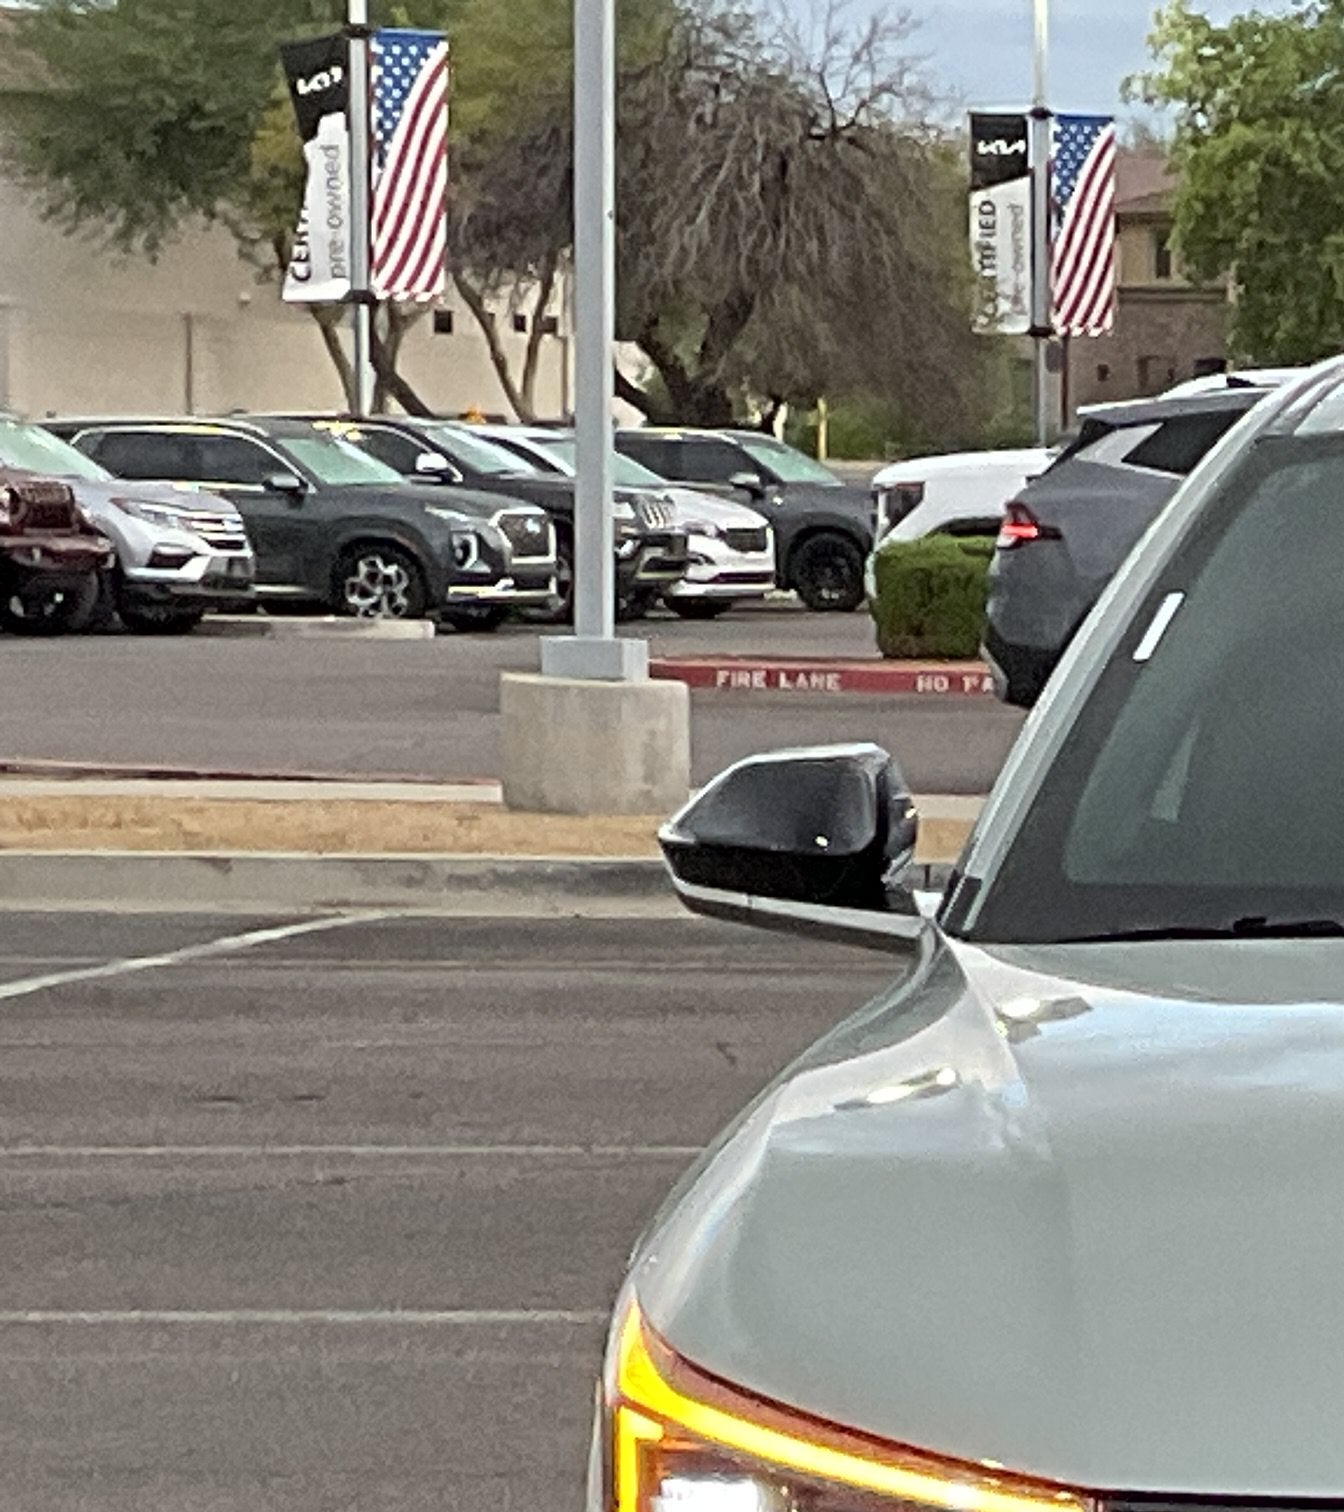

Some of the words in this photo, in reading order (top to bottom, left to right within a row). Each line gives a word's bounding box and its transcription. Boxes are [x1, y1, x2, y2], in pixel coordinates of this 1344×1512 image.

[715, 669, 767, 689] FIRE
[779, 671, 841, 690] LANE
[916, 674, 950, 693] NO
